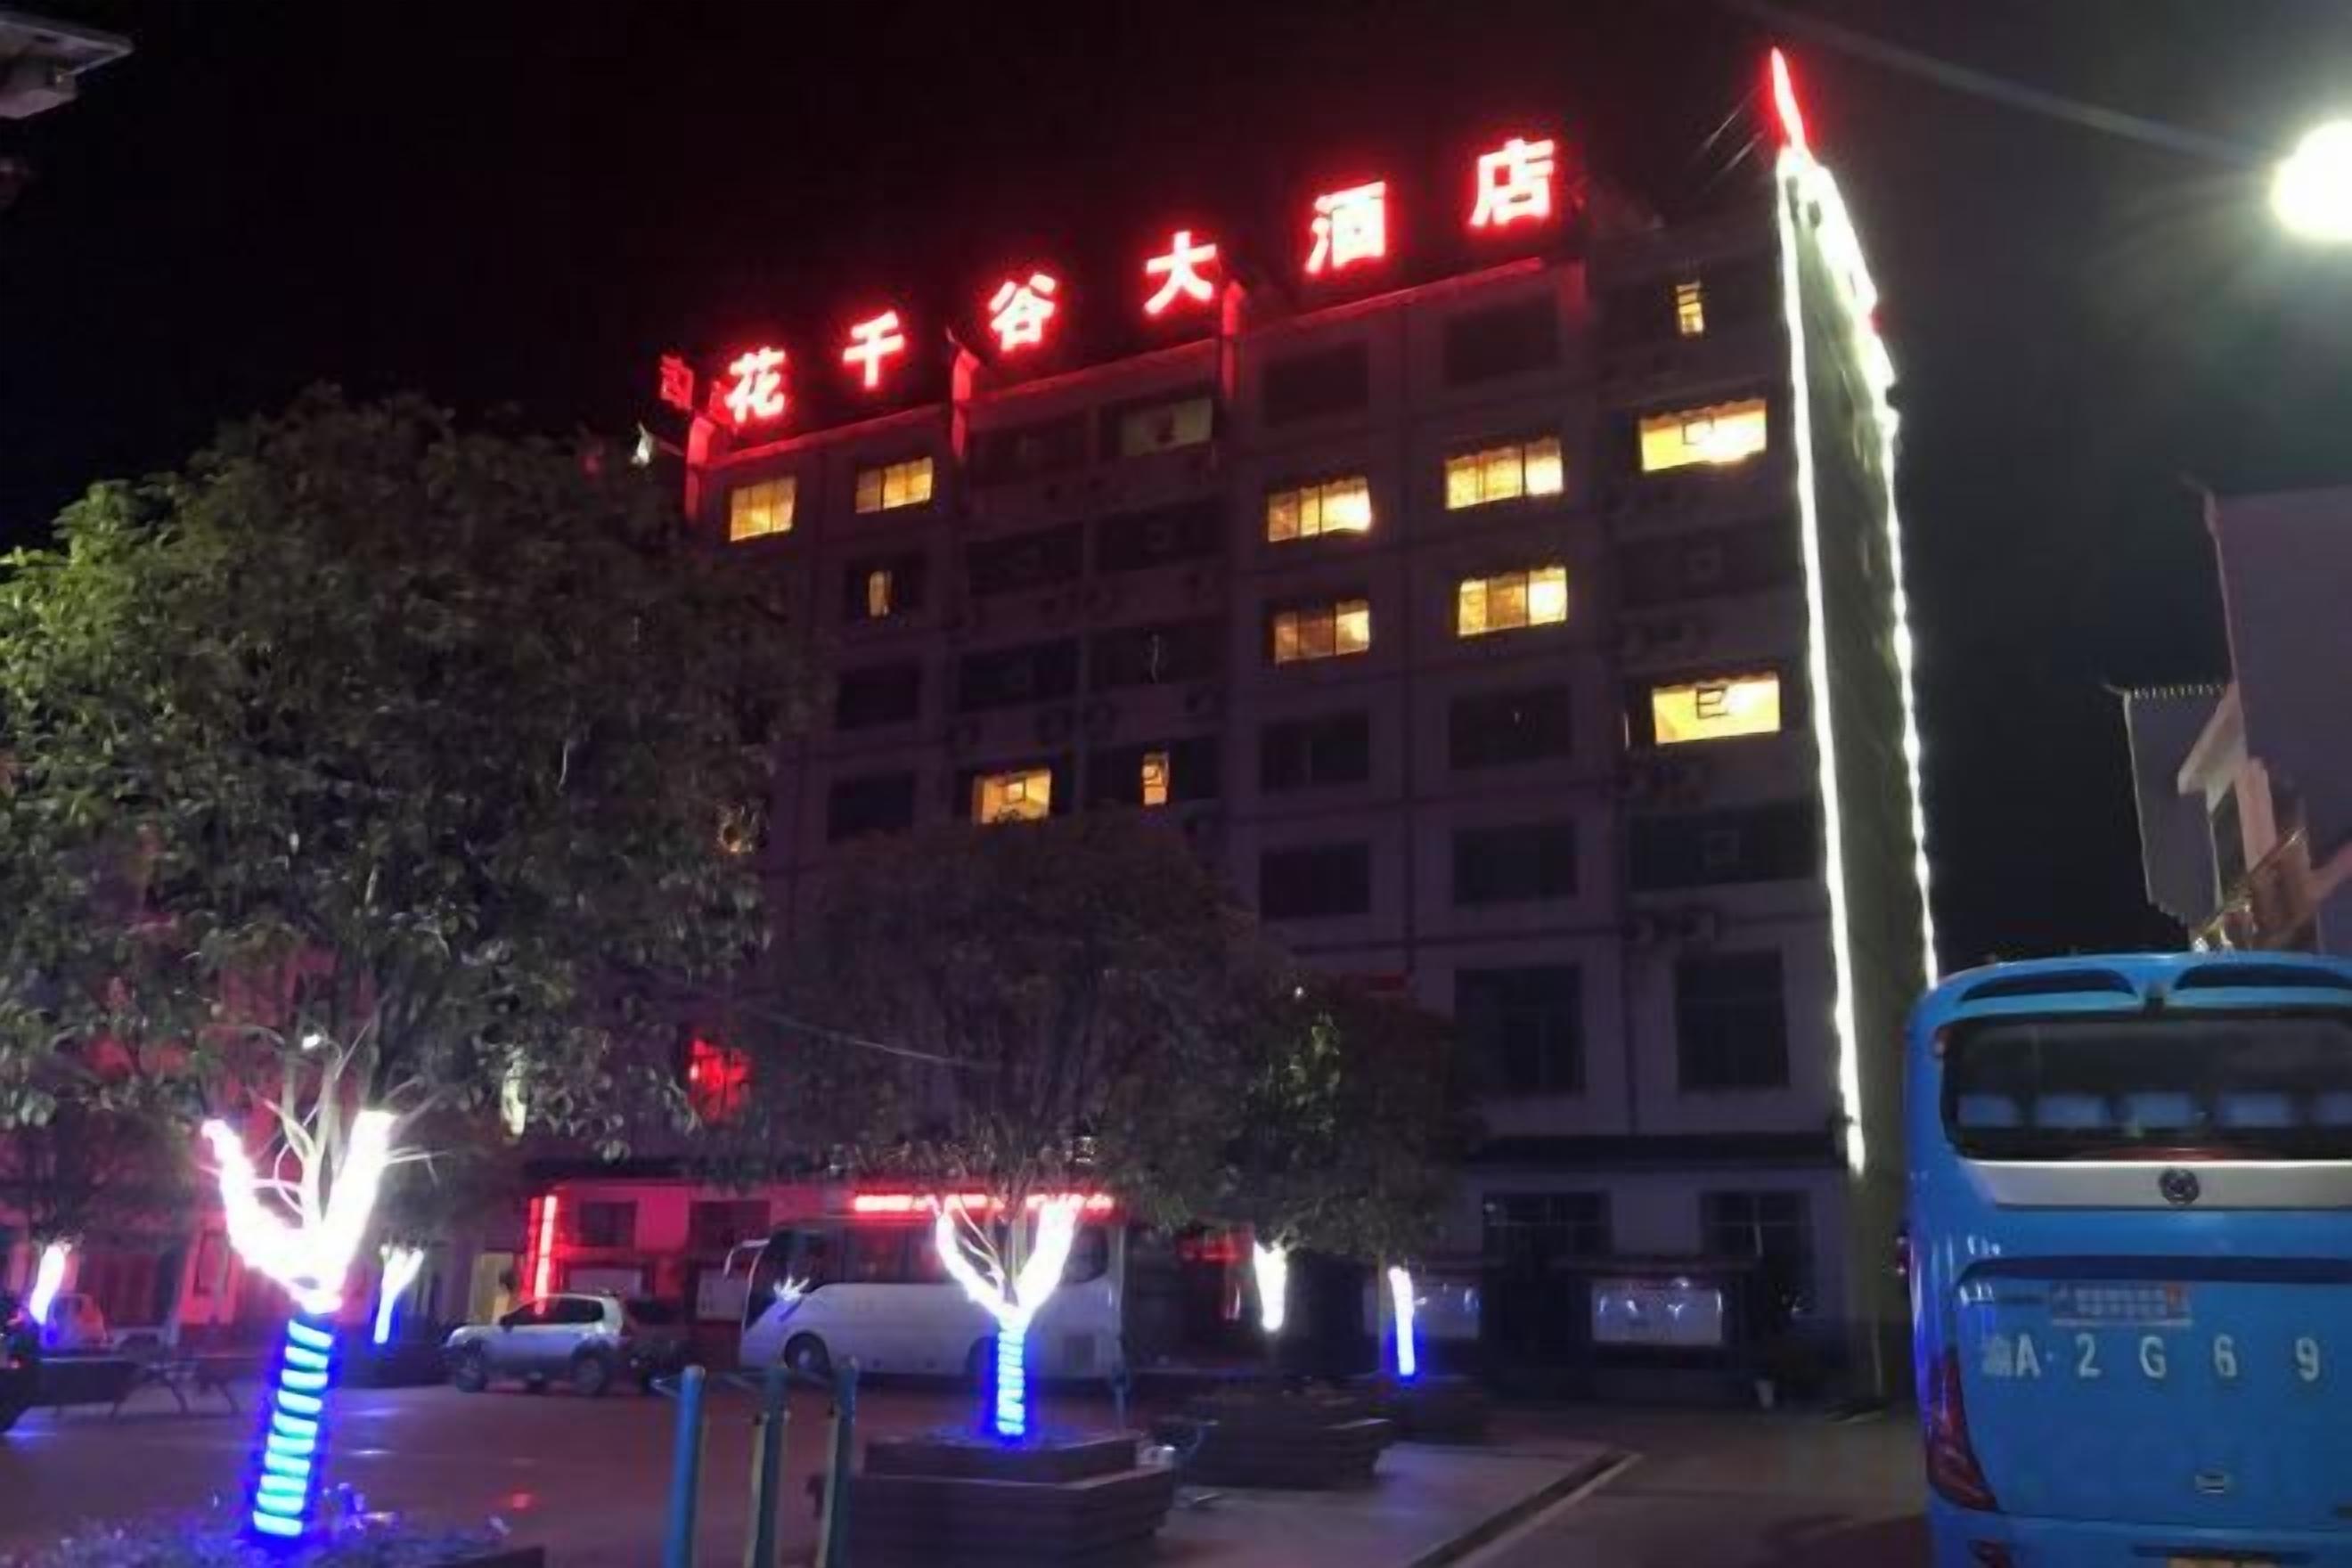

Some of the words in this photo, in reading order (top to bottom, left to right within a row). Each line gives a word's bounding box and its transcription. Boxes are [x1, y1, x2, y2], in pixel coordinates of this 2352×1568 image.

[723, 136, 1556, 425] 花千谷大酒店
